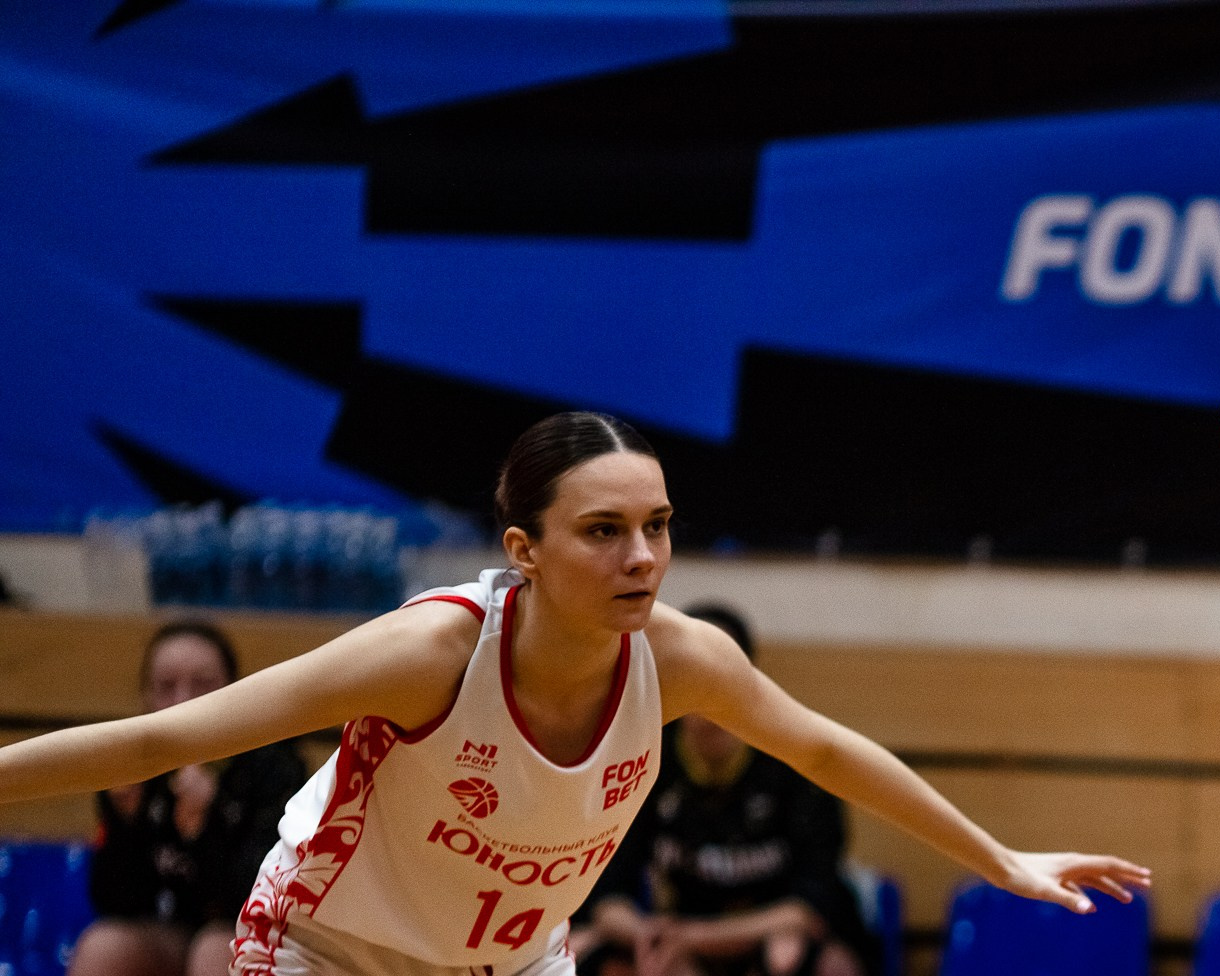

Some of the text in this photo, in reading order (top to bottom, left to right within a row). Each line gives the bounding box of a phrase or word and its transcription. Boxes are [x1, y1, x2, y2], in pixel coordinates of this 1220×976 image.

[455, 754, 498, 768] SPORT
[602, 749, 650, 789] FON
[603, 769, 647, 811] BET
[426, 819, 616, 887] ЮНОСТЬ
[465, 889, 545, 951] 14
